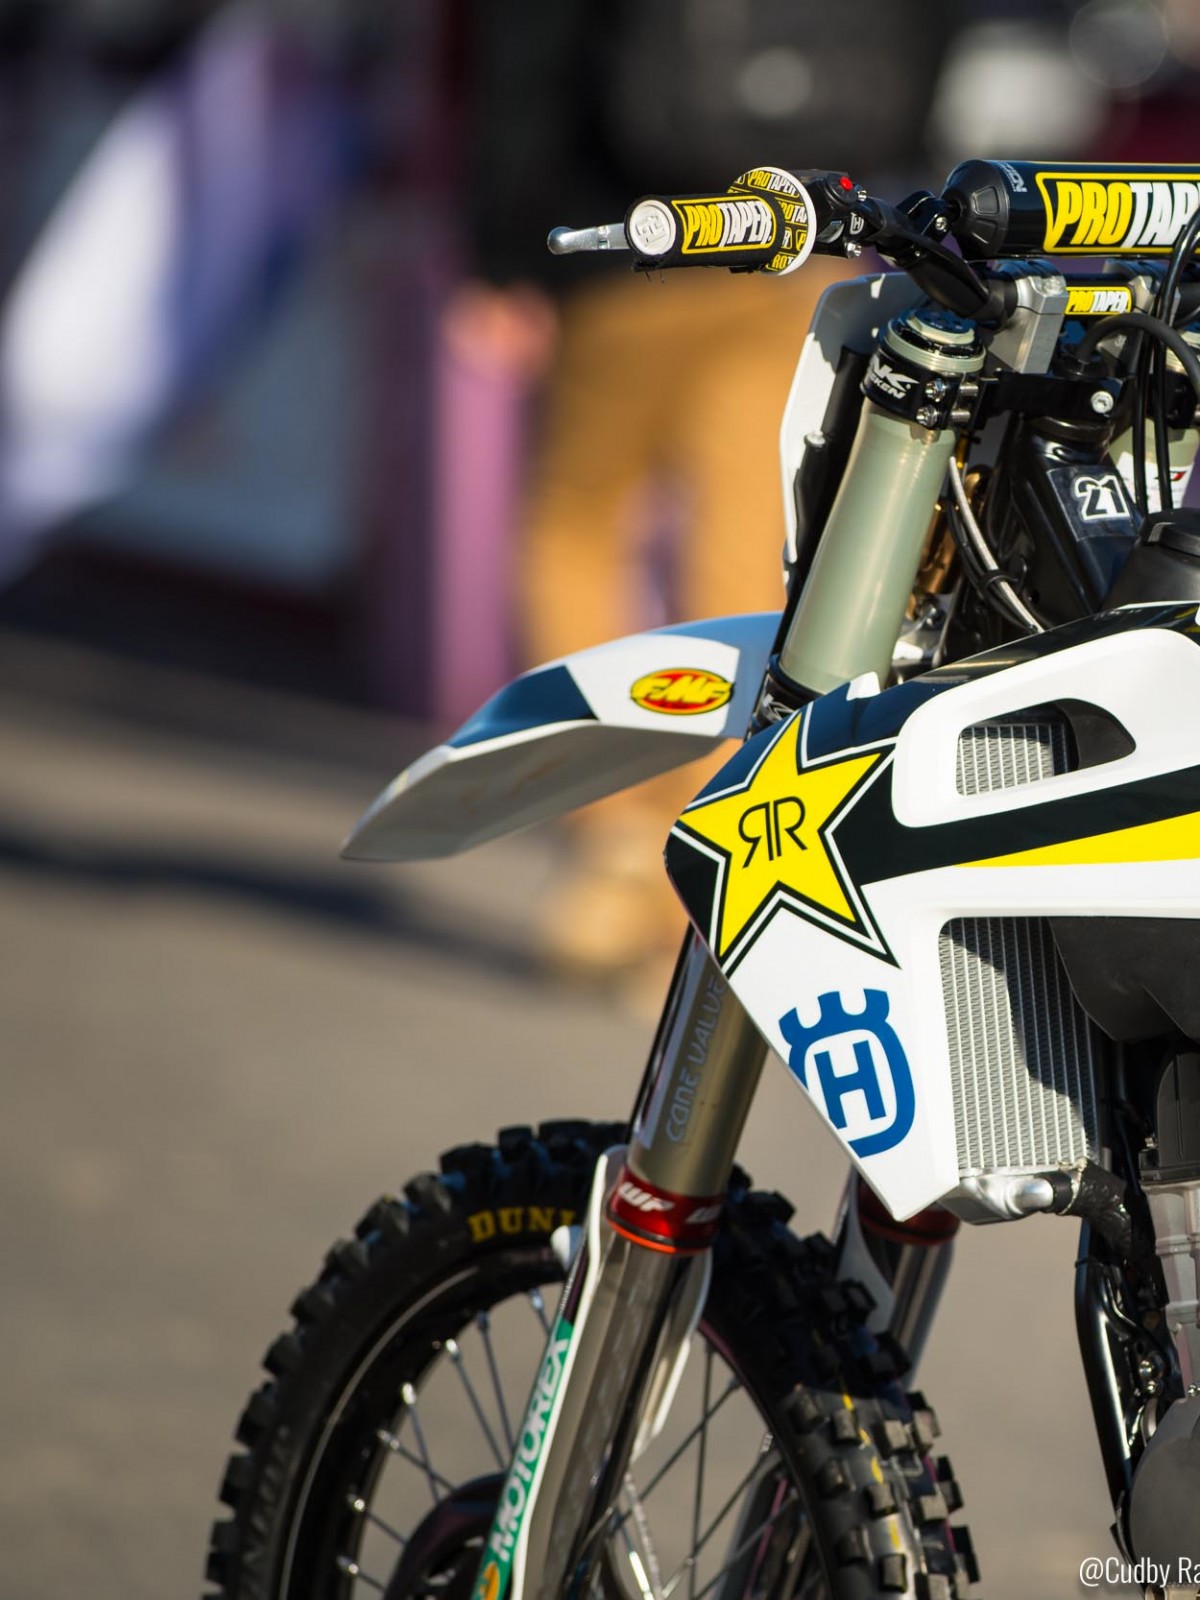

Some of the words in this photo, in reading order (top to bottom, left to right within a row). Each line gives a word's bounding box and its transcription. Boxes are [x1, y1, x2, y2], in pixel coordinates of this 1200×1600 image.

[683, 200, 773, 249] PROTAPER
[1074, 475, 1130, 520] 21
[630, 674, 732, 704] FMF
[490, 1337, 569, 1563] MOTOREX
